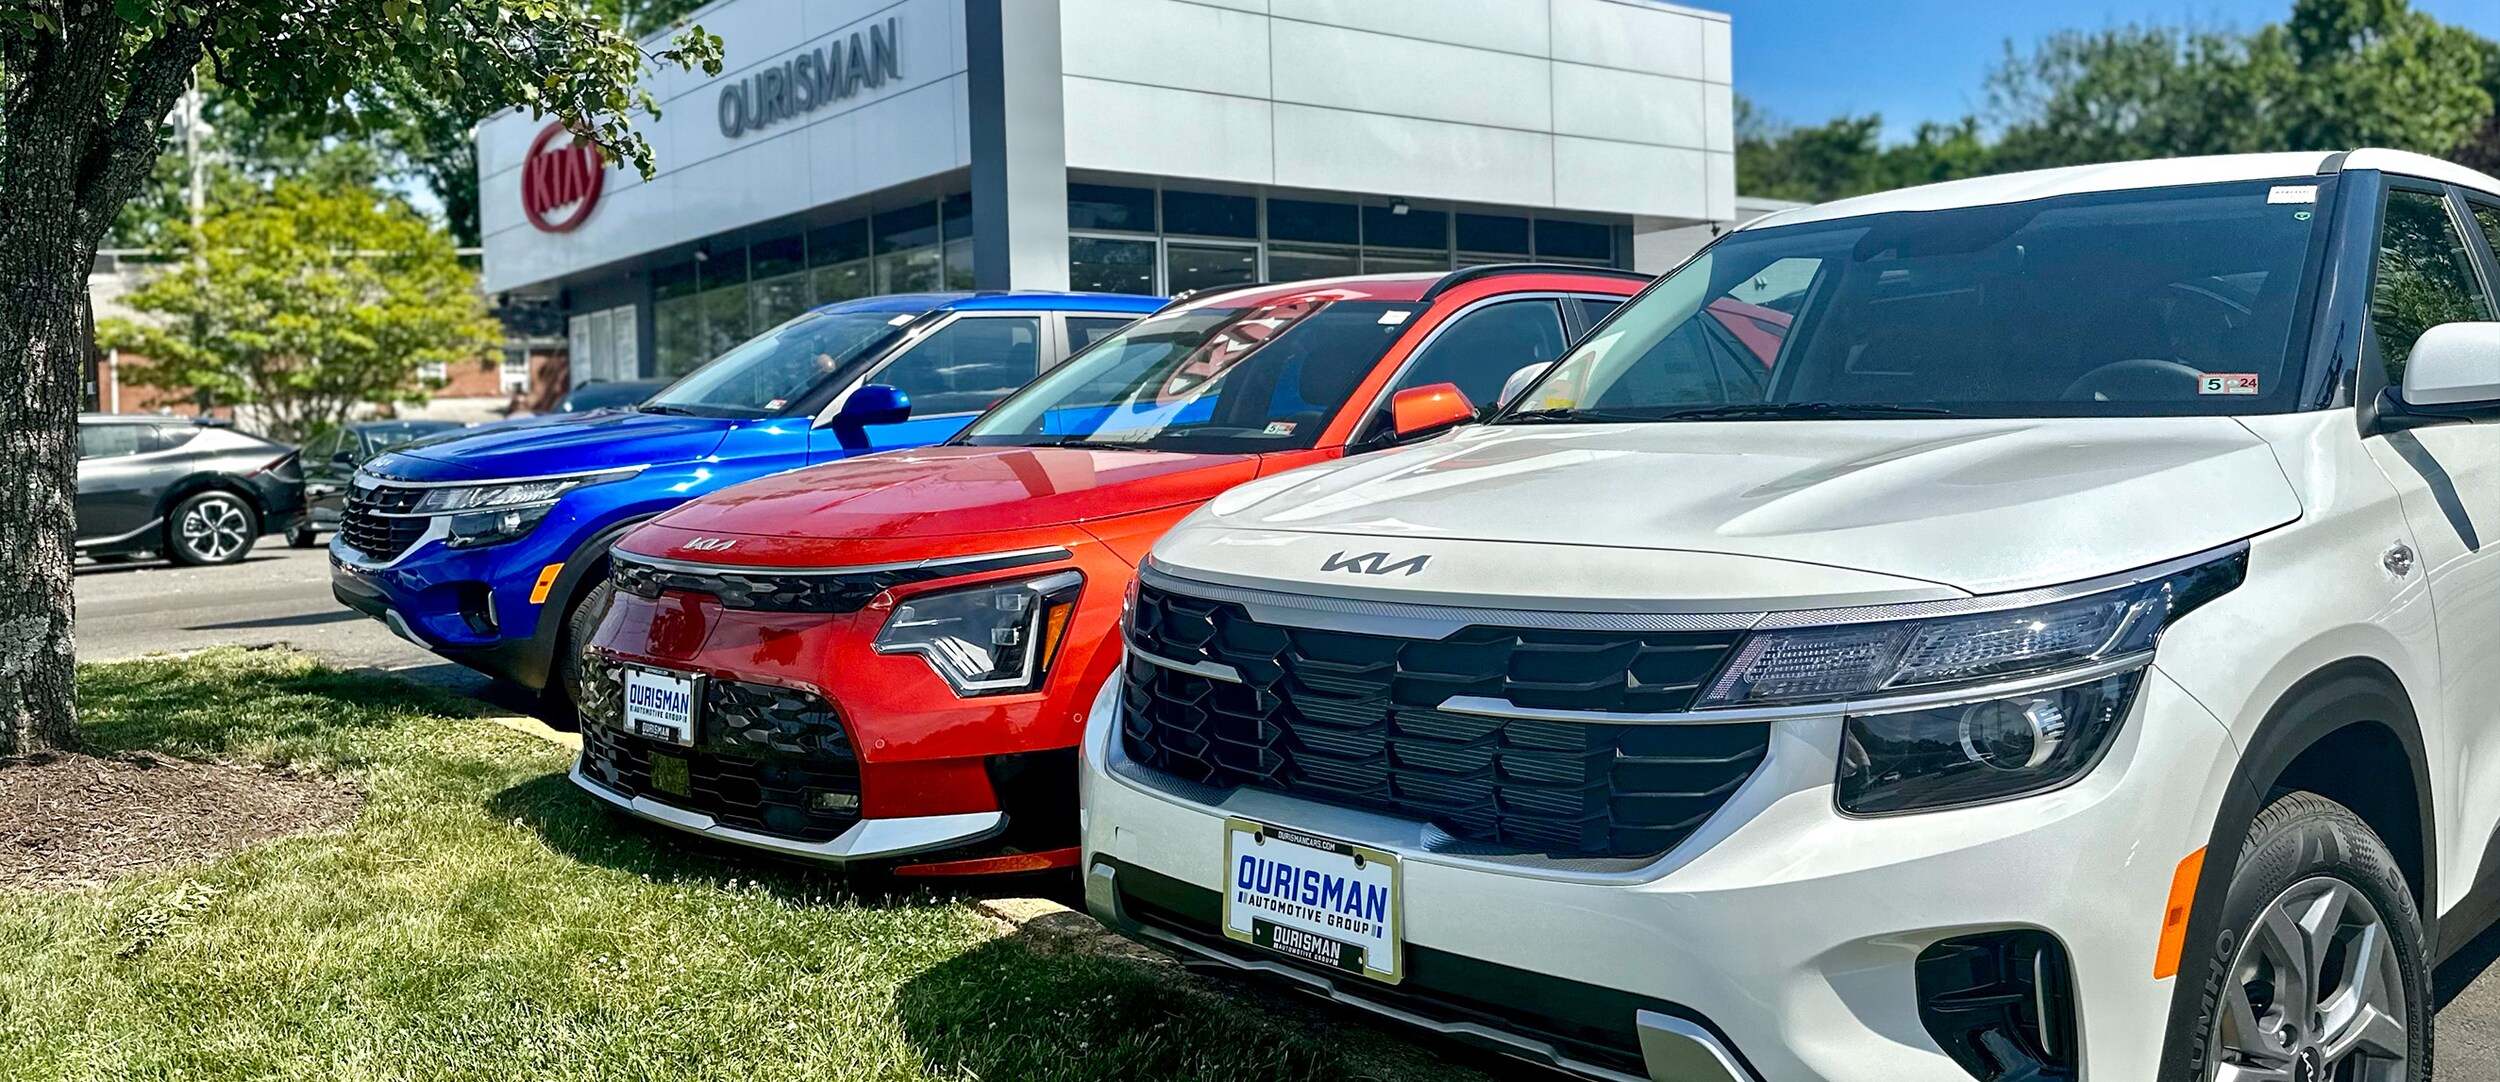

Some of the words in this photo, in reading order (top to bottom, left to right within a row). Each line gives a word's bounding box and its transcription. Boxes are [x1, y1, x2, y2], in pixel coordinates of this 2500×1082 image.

[718, 17, 902, 139] OURISMAN
[532, 142, 585, 214] KIA
[2208, 378, 2221, 390] 5
[2240, 378, 2256, 388] 24
[682, 536, 737, 552] KIA
[1320, 550, 1433, 576] KIA
[629, 683, 689, 714] OURISMAN
[634, 705, 664, 719] AUTOMOTIVE
[665, 712, 683, 722] GROUP
[1278, 830, 1336, 851] OURISMANCARS.COM
[1237, 854, 1388, 923] OURISMAN
[1248, 894, 1322, 923] AUTOMOTIVE
[1327, 913, 1369, 935] GROUP
[1273, 925, 1341, 959] OURISMAN
[2191, 928, 2235, 1070] UMHO
